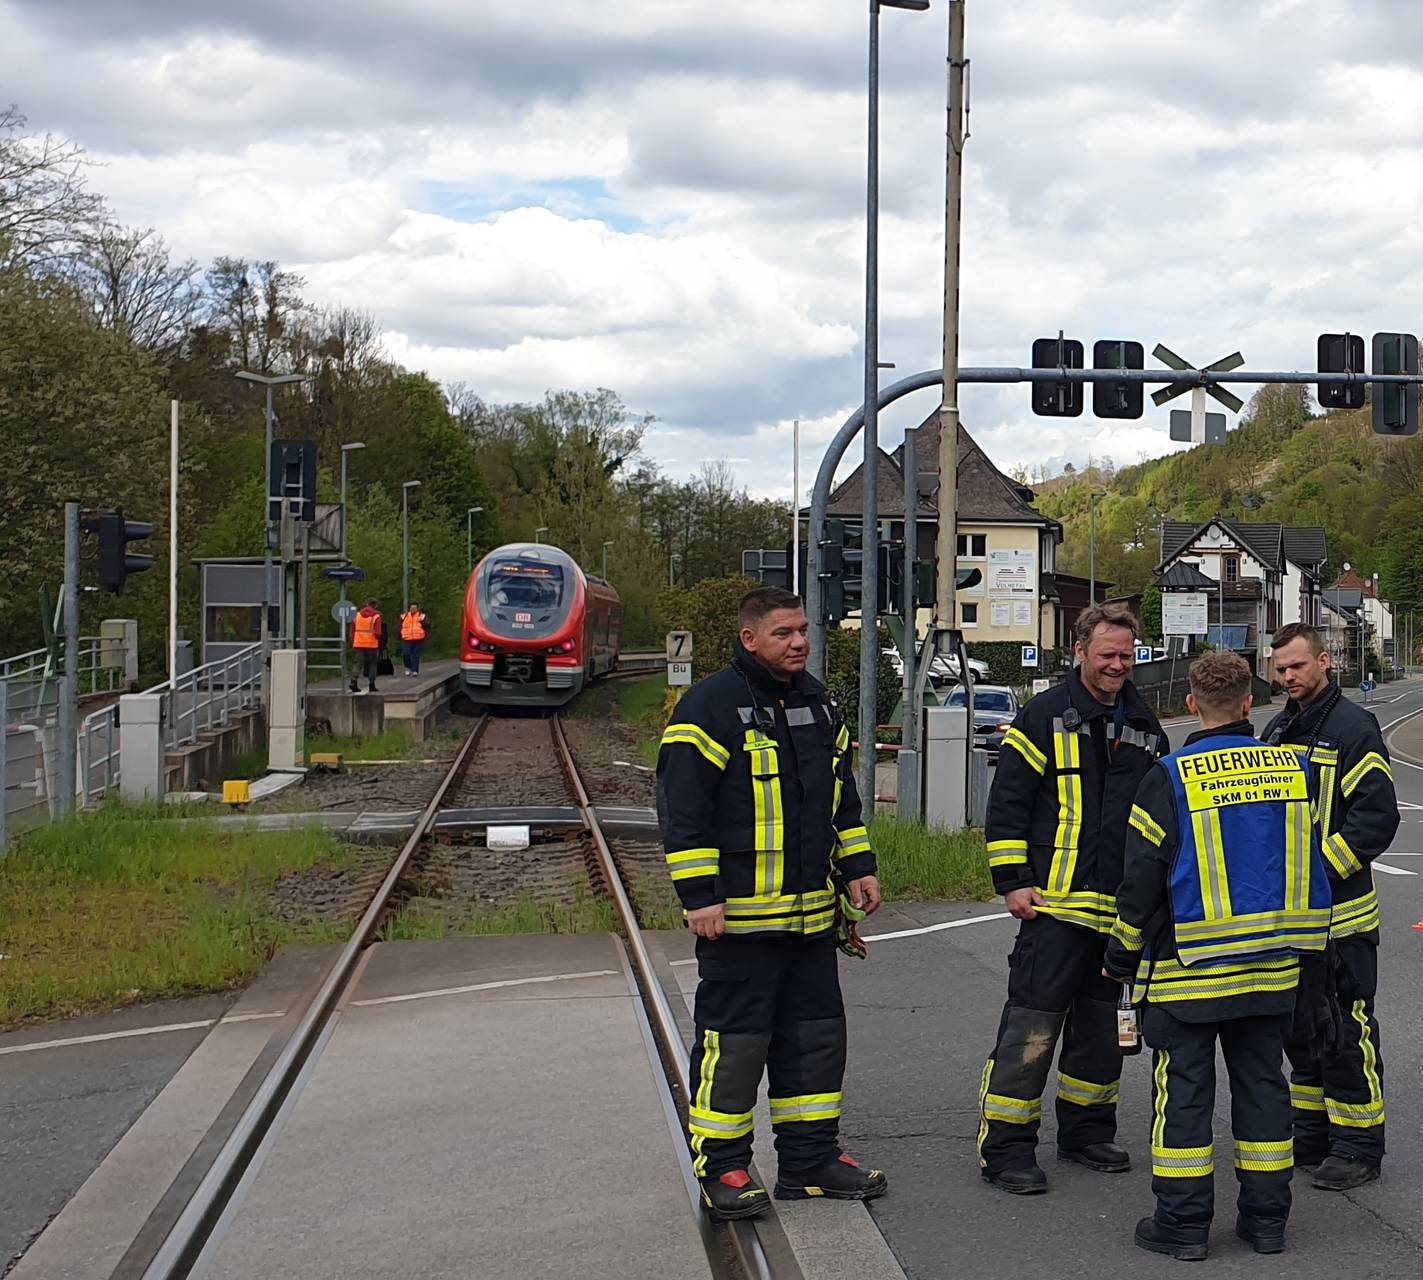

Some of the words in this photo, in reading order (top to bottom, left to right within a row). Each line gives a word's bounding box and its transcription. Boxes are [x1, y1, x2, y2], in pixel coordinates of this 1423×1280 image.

[674, 635, 685, 657] 7
[1026, 648, 1034, 659] P
[1140, 649, 1148, 659] P
[1180, 750, 1297, 778] FEUERWEHR
[1201, 774, 1294, 792] Fahrzeugführer
[1212, 793, 1241, 805] SKM
[1245, 790, 1258, 800] 01
[1263, 789, 1282, 799] RW
[1285, 788, 1290, 798] 1
